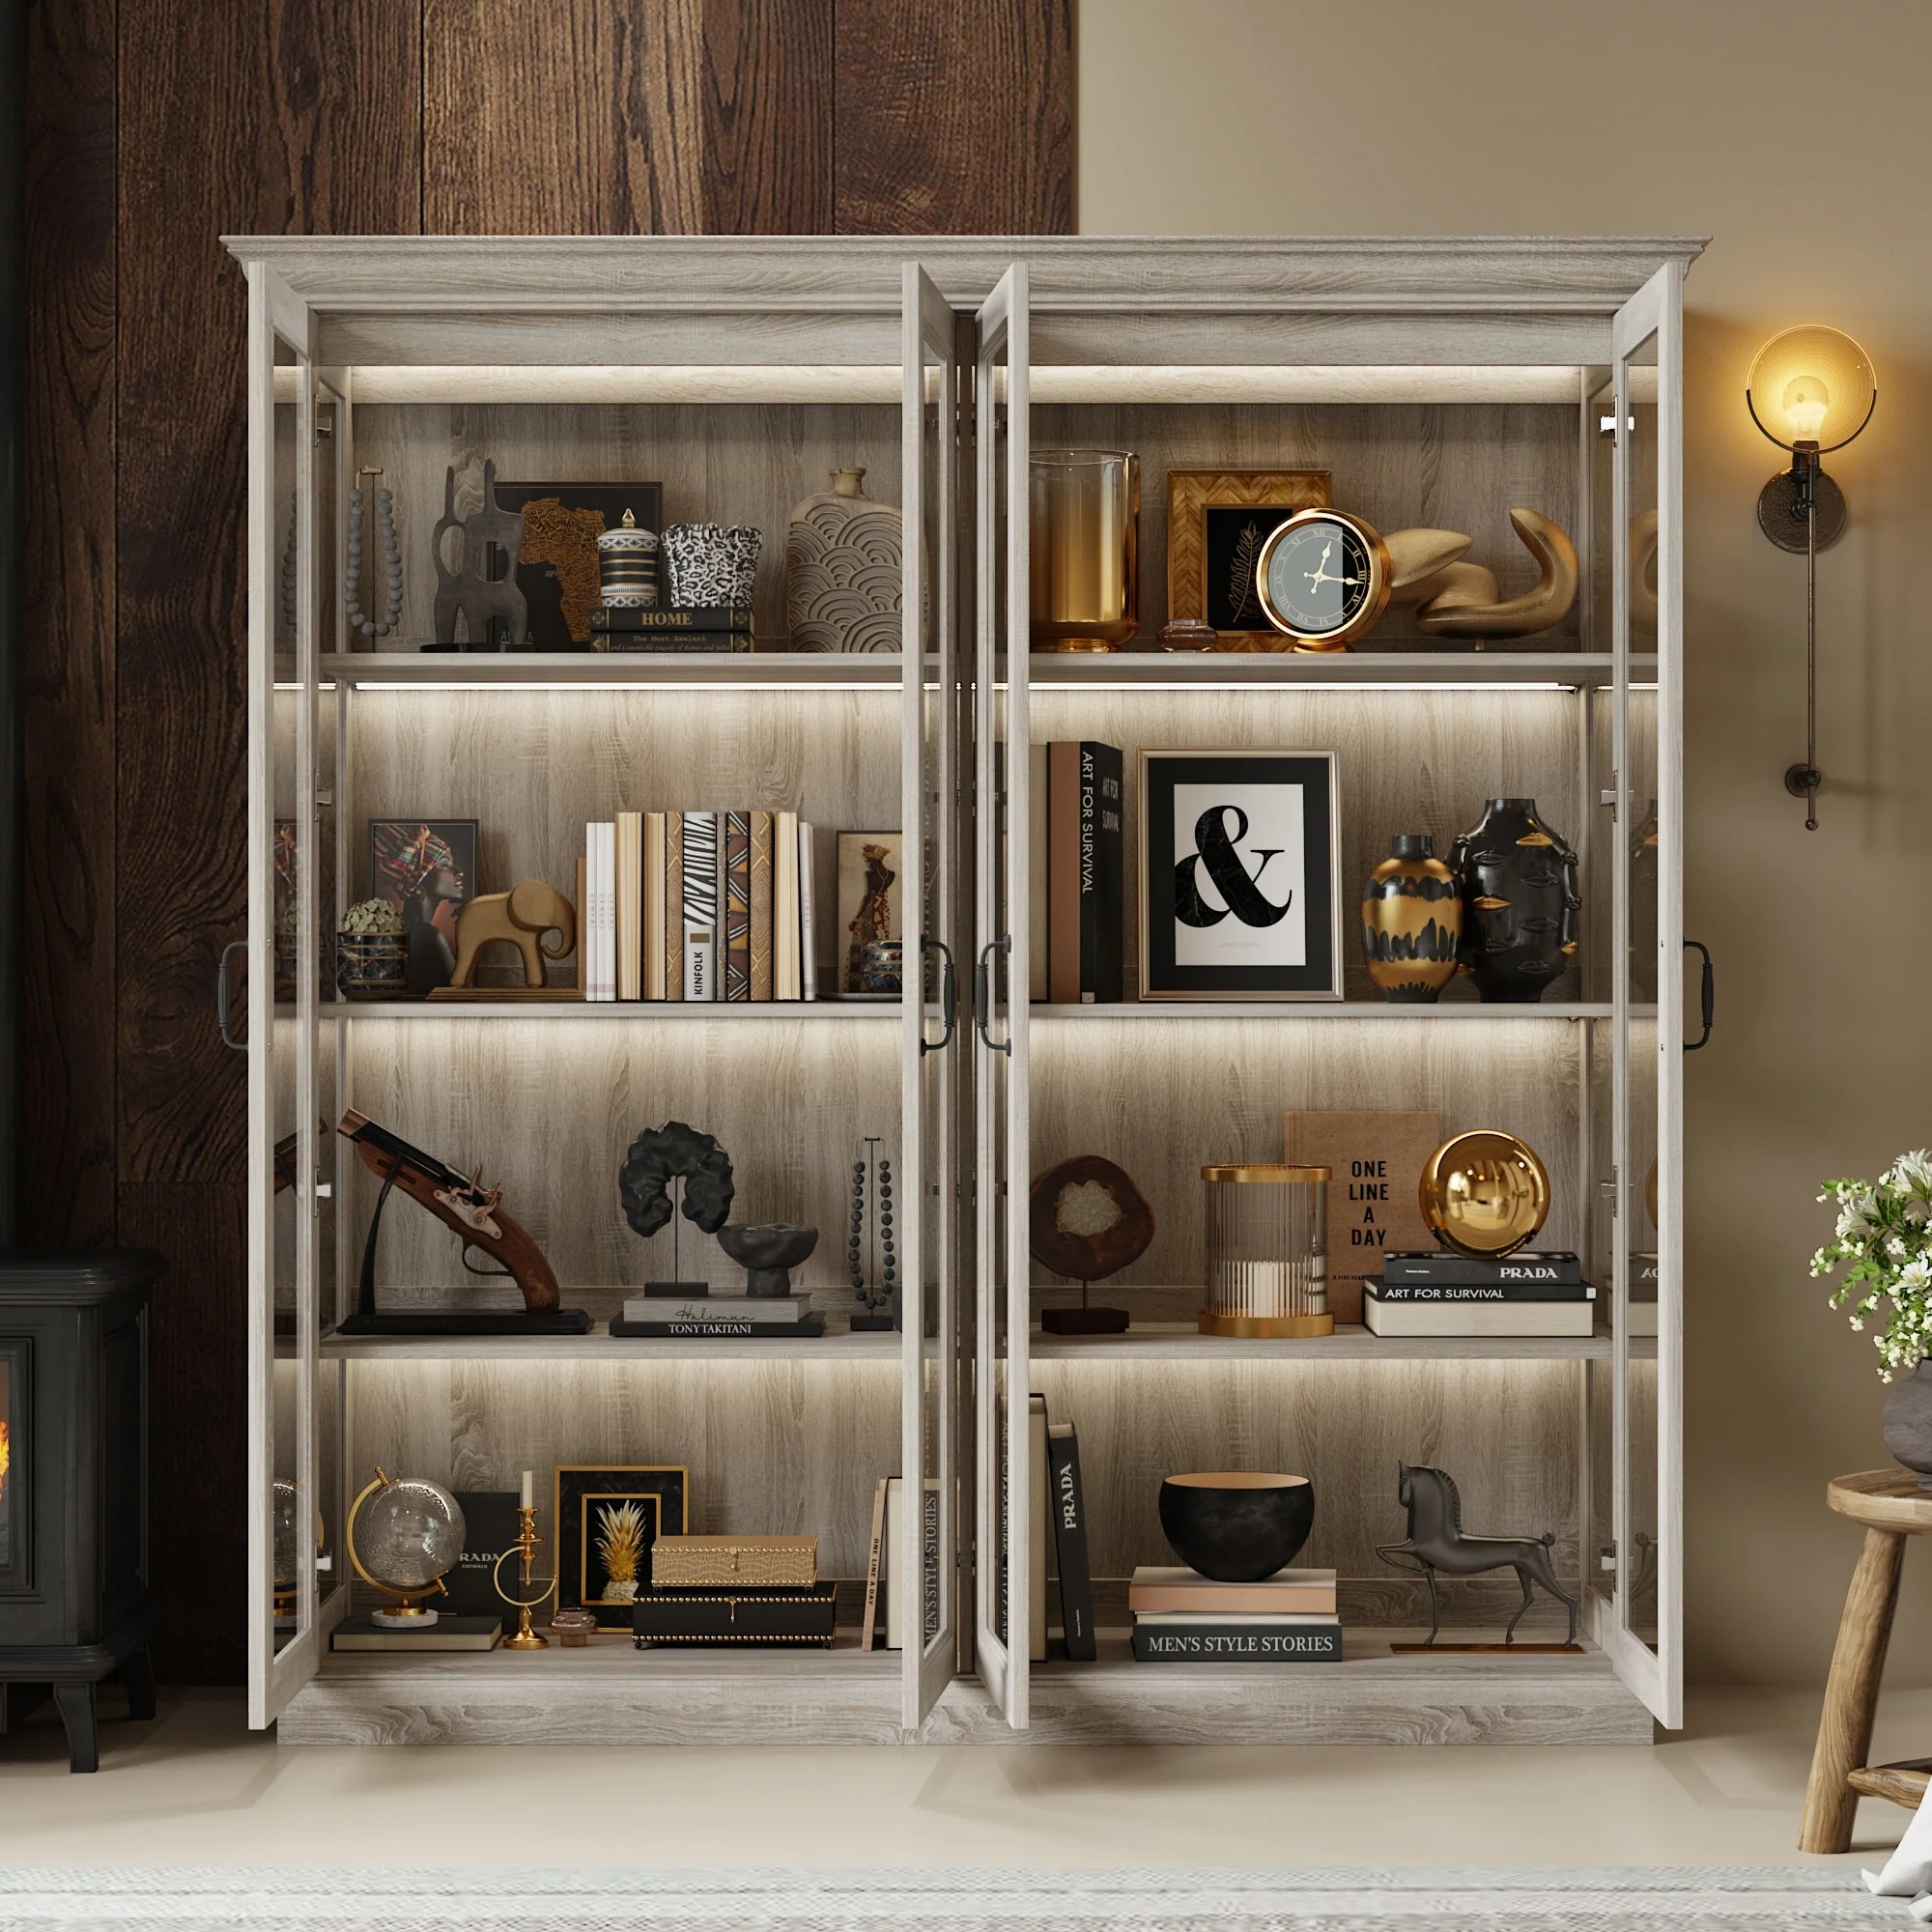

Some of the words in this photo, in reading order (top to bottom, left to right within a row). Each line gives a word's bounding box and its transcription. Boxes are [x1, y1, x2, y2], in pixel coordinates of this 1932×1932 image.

[641, 612, 693, 626] HOME
[1082, 751, 1094, 781] ART
[1082, 786, 1094, 818] FOR
[1082, 823, 1094, 894] SURVIVAL
[1175, 805, 1293, 927] &
[695, 952, 703, 995] KINFOLK
[1351, 1160, 1387, 1178] ONE
[1349, 1183, 1389, 1201] LINE
[1363, 1207, 1375, 1223] A
[1351, 1229, 1386, 1246] DAY
[1499, 1267, 1558, 1279] PRADA
[1385, 1289, 1409, 1298] ART
[1414, 1289, 1441, 1298] FOR
[1445, 1289, 1504, 1298] SURVIVAL
[668, 1324, 699, 1334] TONY
[700, 1324, 752, 1334] TAKITANI
[1060, 1463, 1077, 1529] PRADA
[924, 1496, 937, 1552] STORIES
[459, 1552, 500, 1562] RADA
[1205, 1636, 1258, 1652] STYLE
[1262, 1636, 1333, 1652] STORIES
